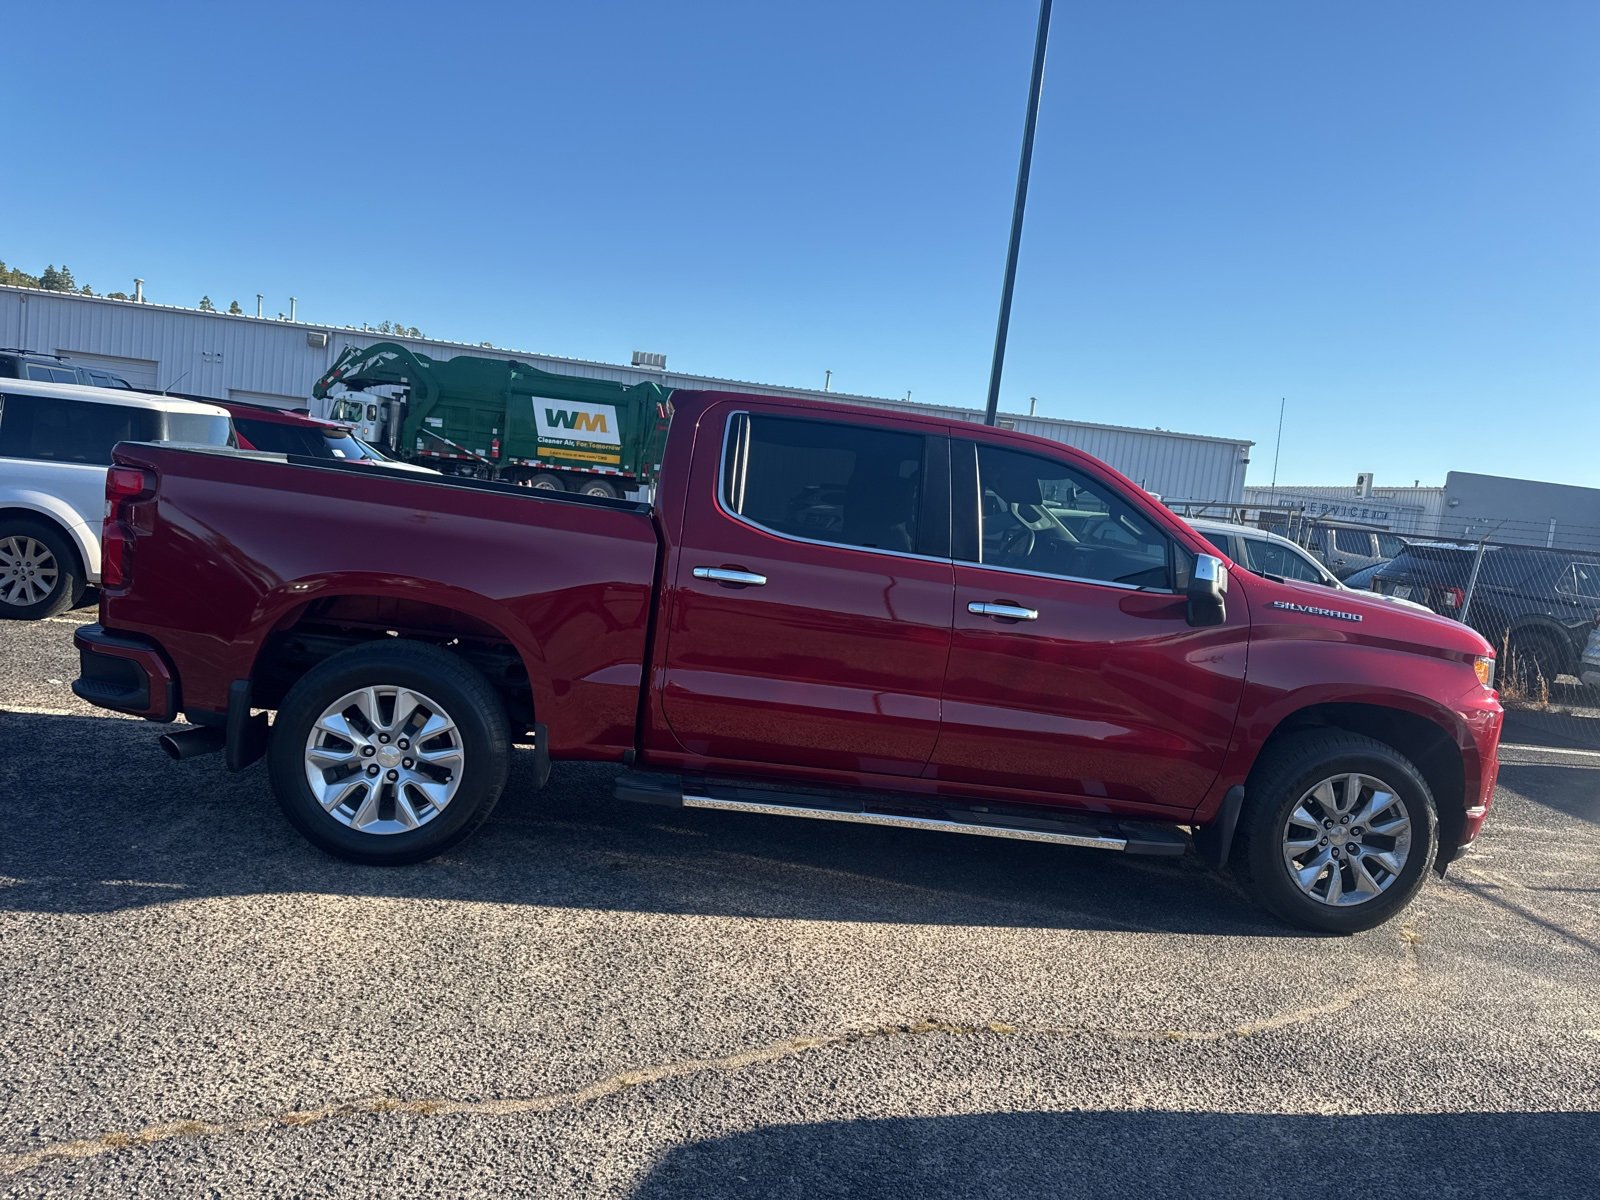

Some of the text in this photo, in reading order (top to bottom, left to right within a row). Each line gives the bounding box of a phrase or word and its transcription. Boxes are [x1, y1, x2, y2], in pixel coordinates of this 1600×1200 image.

[545, 408, 608, 433] WM
[537, 436, 563, 445] Cleaner
[1273, 600, 1363, 622] SILVERADO
